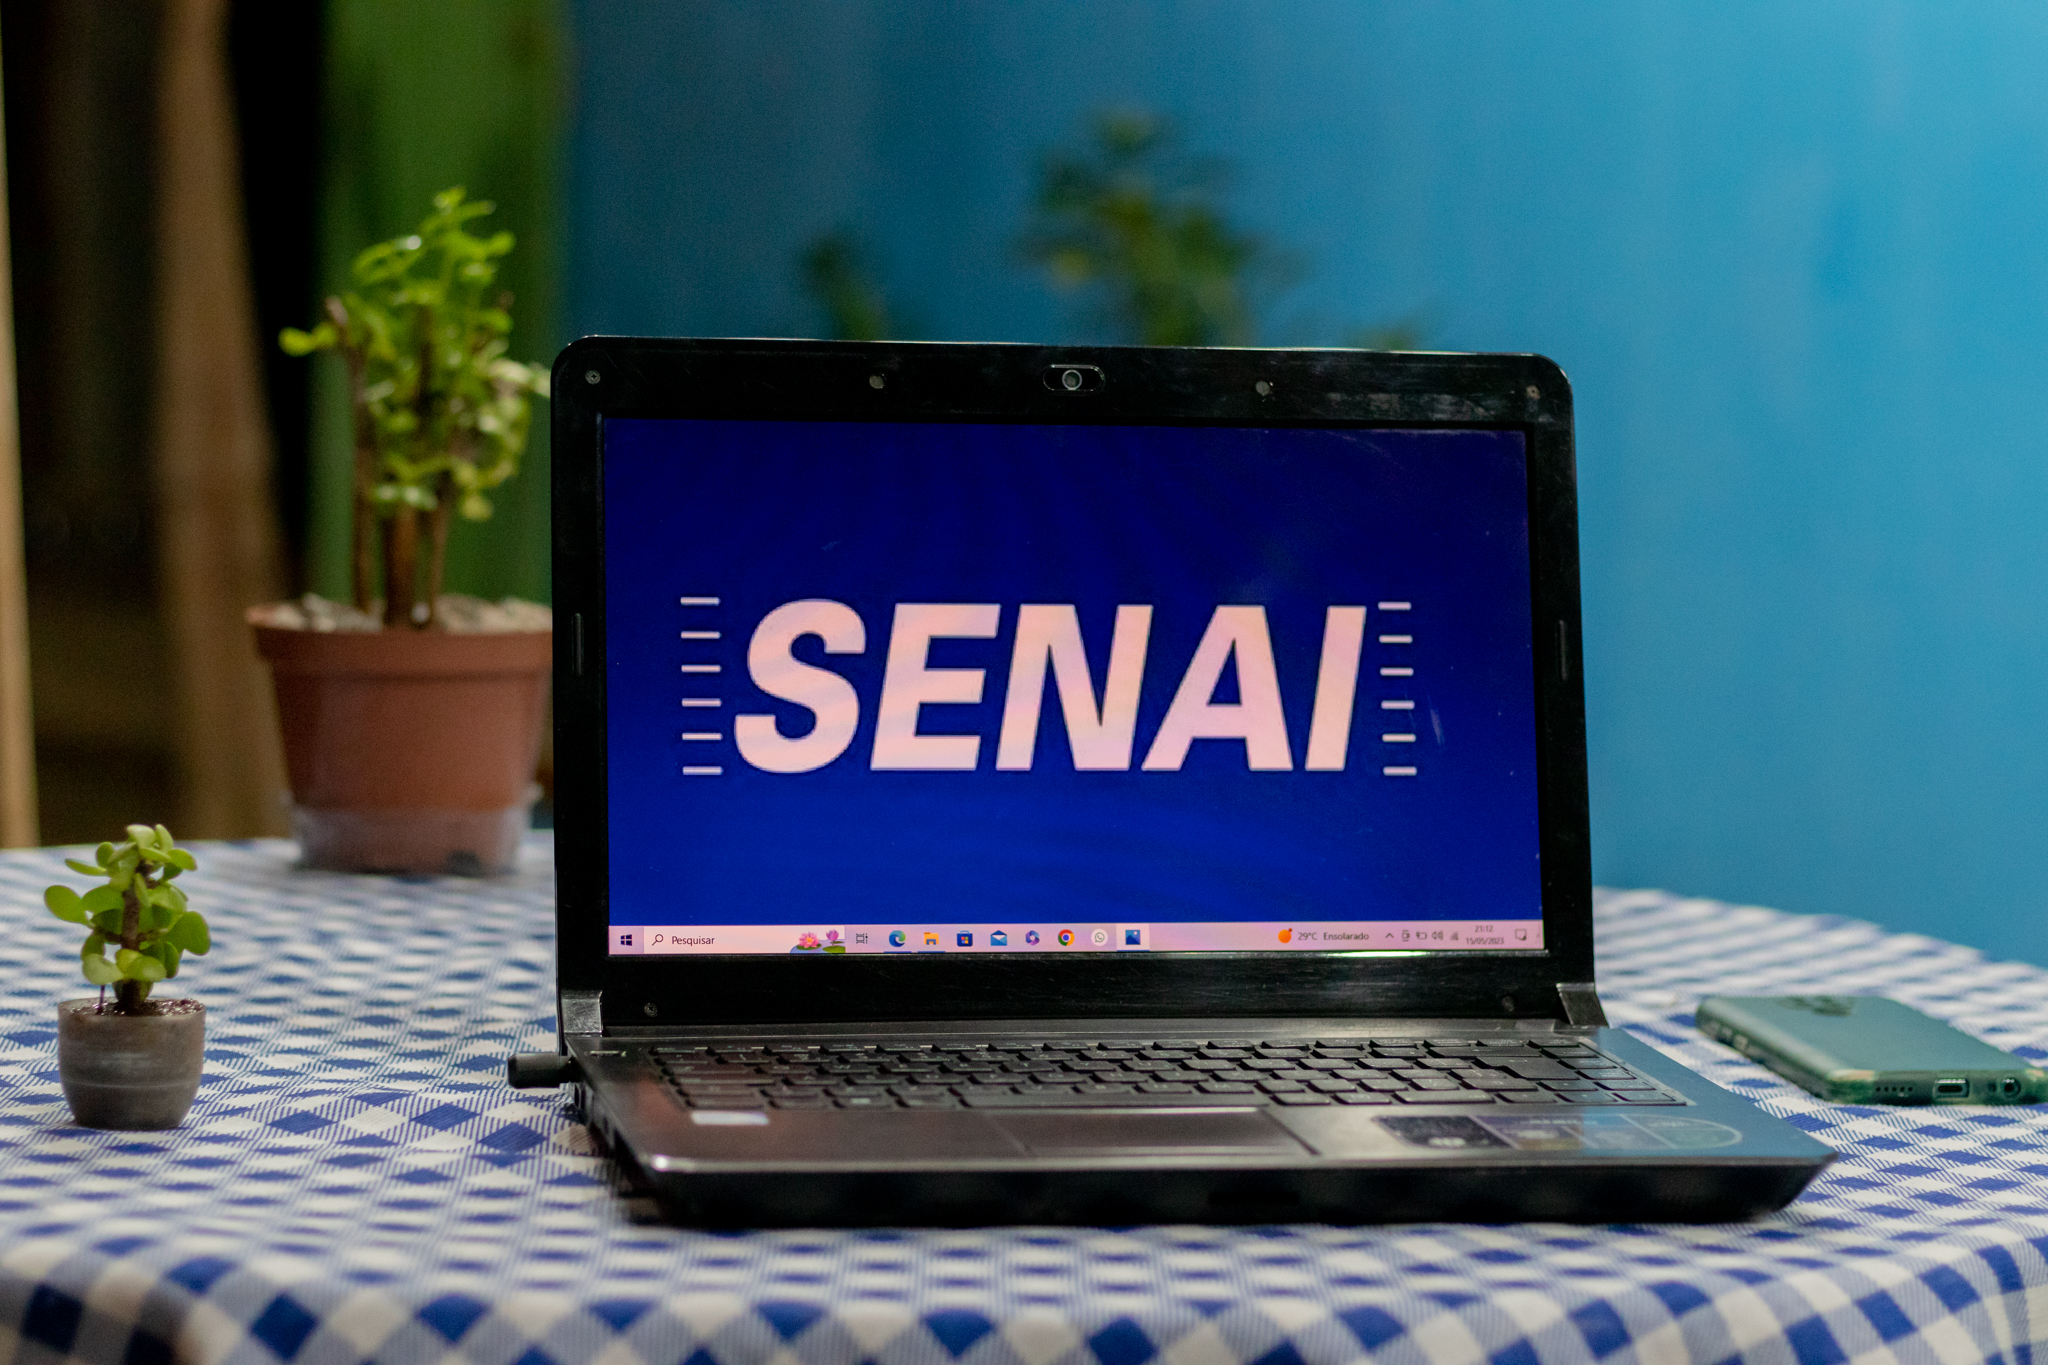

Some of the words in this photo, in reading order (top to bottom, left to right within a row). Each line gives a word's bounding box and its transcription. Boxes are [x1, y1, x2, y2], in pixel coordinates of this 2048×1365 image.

[734, 599, 1367, 774] SENAI
[1474, 925, 1494, 933] 21:12
[671, 935, 716, 947] Pesquisar
[1297, 932, 1318, 941] 29°C
[1323, 932, 1370, 941] Ensolarado
[1466, 937, 1505, 945] 15/05/2023
